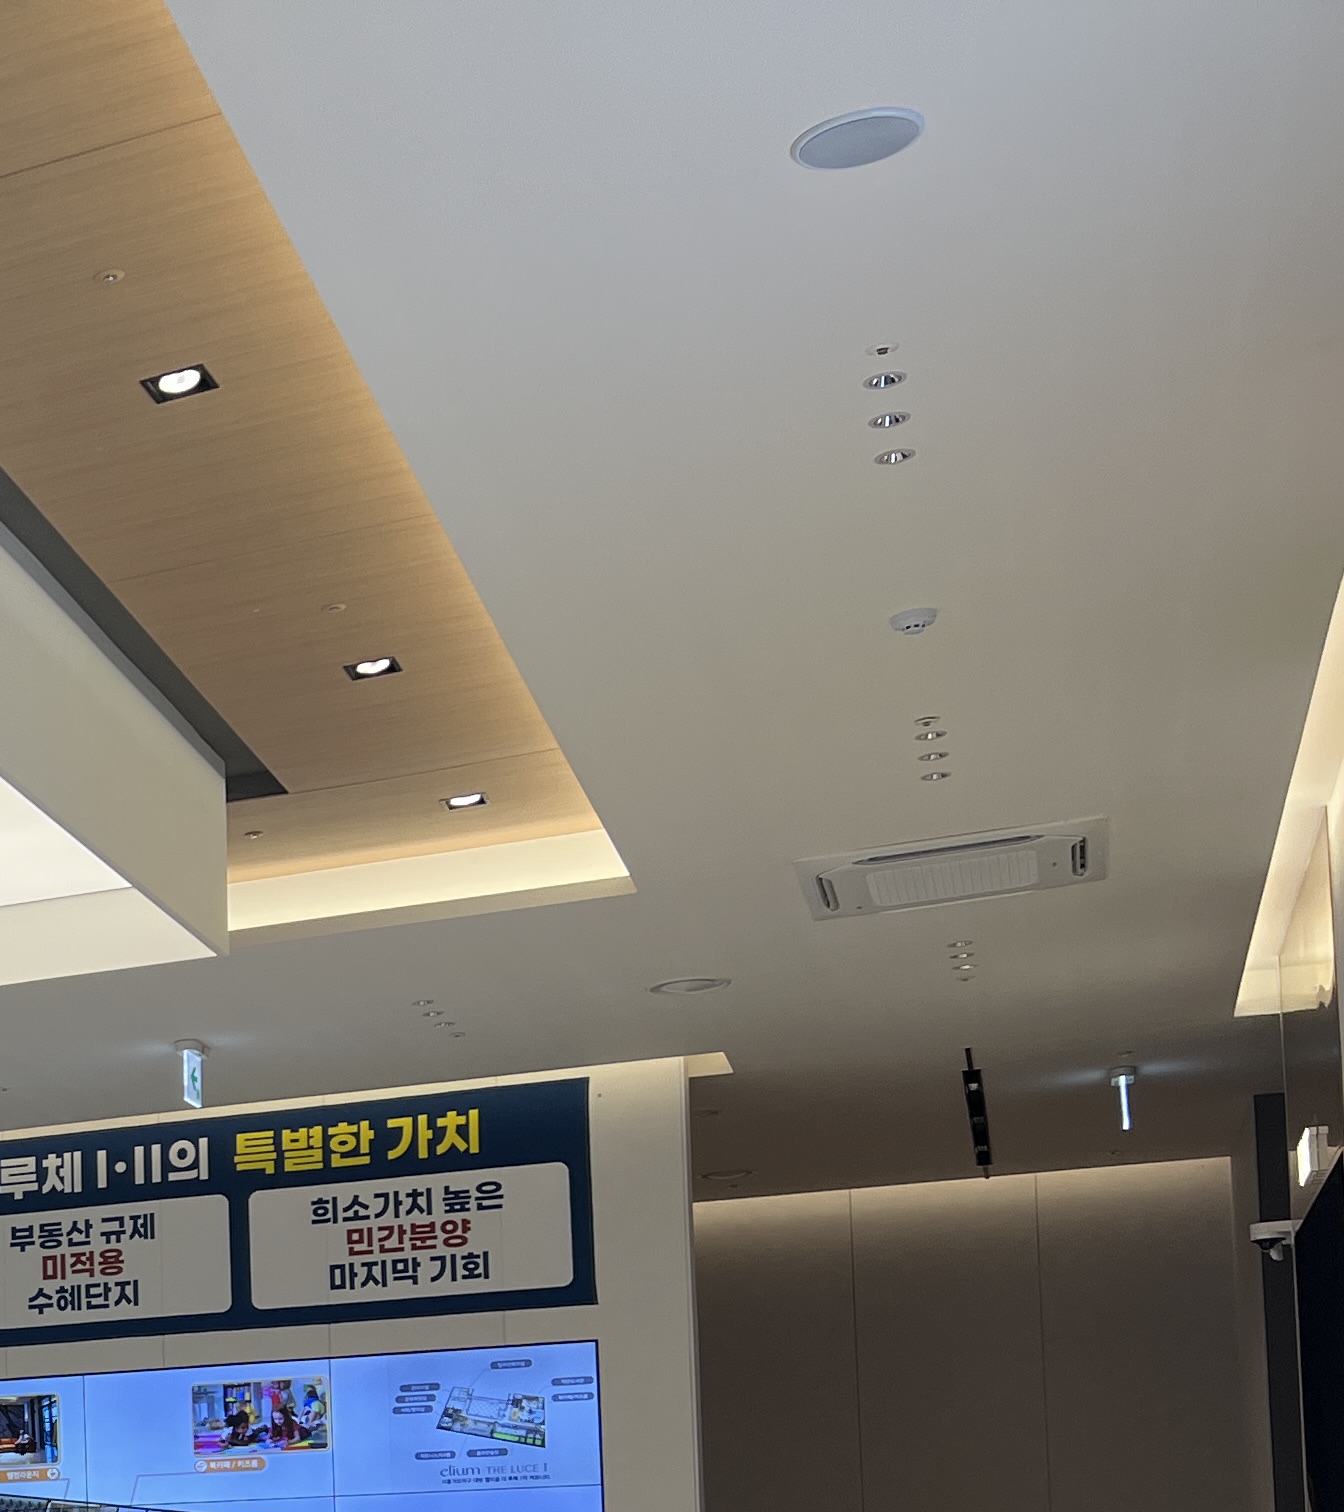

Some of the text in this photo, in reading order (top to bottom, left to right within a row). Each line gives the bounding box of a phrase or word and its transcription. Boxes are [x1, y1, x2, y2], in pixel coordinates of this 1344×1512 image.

[234, 1120, 375, 1174] 특별한
[386, 1108, 480, 1160] 가치
[310, 1180, 504, 1225] 희소가치 높은
[9, 1212, 155, 1253] 부동산 규제
[346, 1218, 471, 1257] 민간분양
[42, 1248, 125, 1281] 미적용
[329, 1250, 490, 1291] 마지막 기회
[26, 1279, 141, 1316] 수혜단지
[439, 1463, 481, 1478] elium
[485, 1465, 507, 1474] THE
